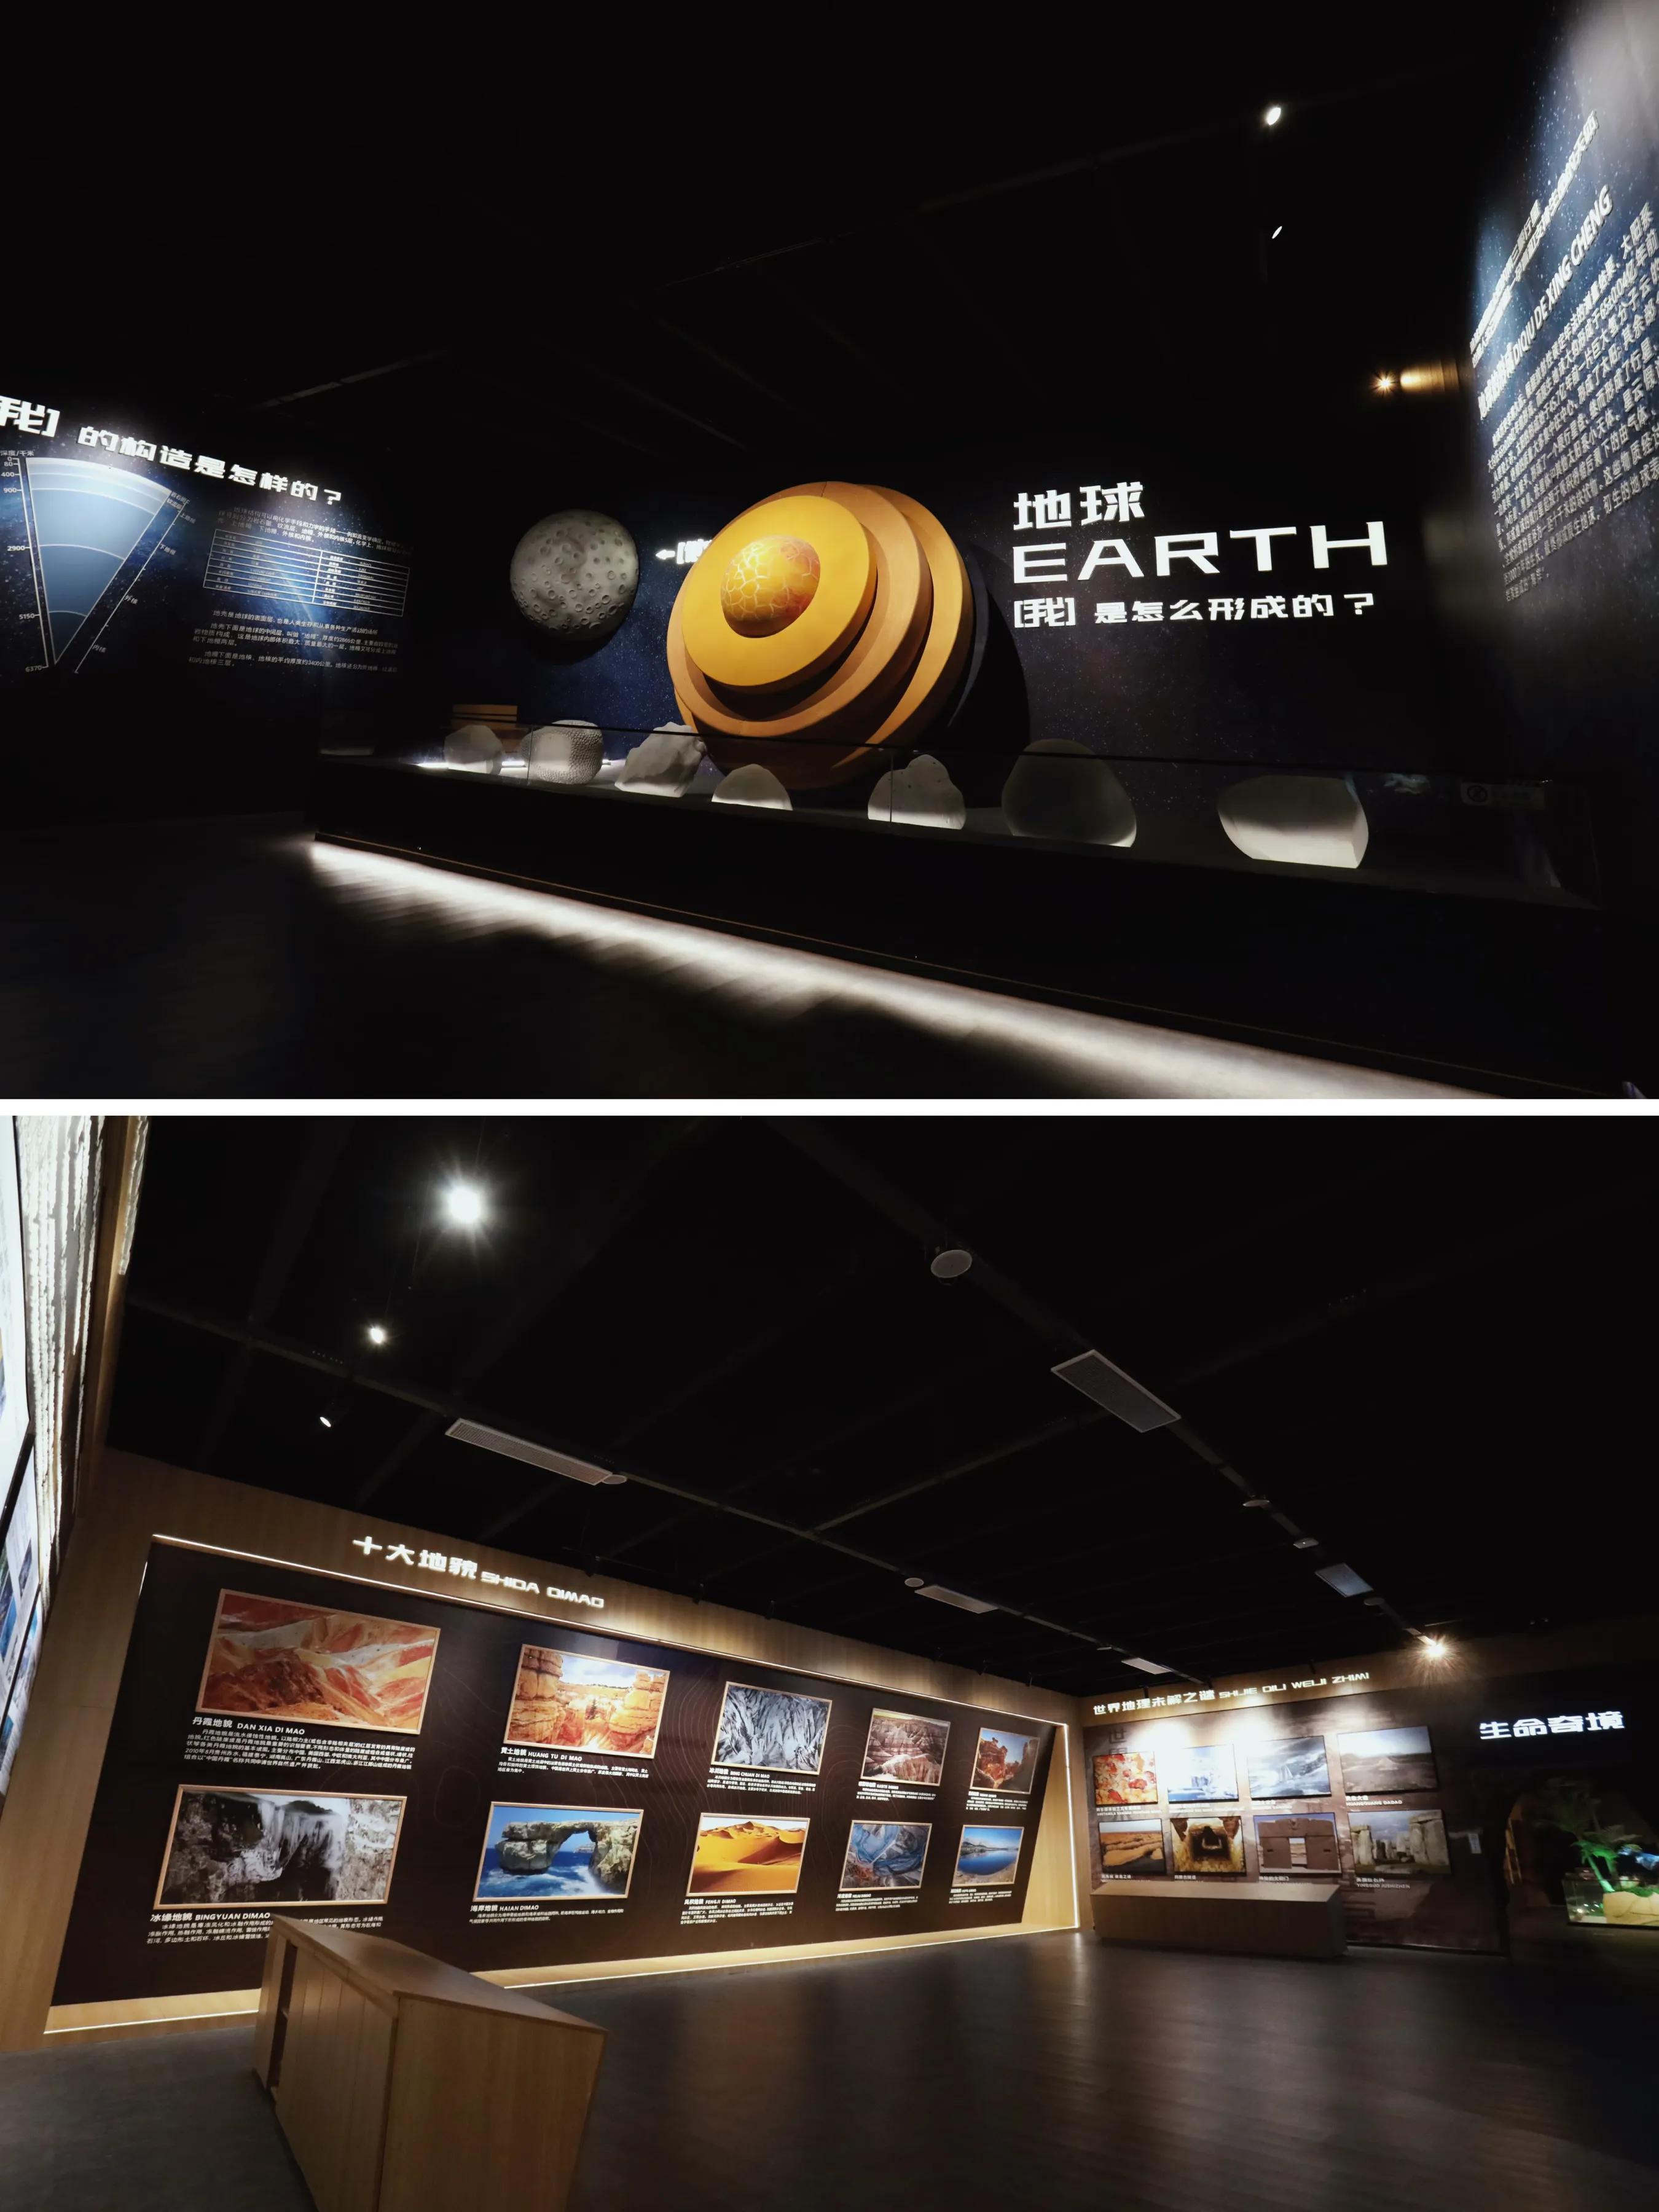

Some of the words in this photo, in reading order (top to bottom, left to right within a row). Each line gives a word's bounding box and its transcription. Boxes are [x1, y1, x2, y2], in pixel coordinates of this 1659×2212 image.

[1513, 318, 1536, 366] DIQIU
[1534, 296, 1551, 330] DE
[1546, 254, 1574, 311] XING
[1570, 184, 1614, 267] CHENG
[1013, 481, 1145, 531] 地球
[1013, 521, 1388, 583] EARTH
[1094, 593, 1374, 625] 是怎么形成的？
[352, 1535, 478, 1580] 十大地貌
[480, 1571, 540, 1594] SHIDA
[1092, 1689, 1215, 1716] 世界地理未解之谜
[1218, 1687, 1258, 1699] SHIJIE
[1332, 1672, 1370, 1684] ZHIMI
[192, 1716, 233, 1728] 丹霞地貌
[285, 1727, 305, 1735] MAO
[1480, 1711, 1625, 1740] 生命奇境
[500, 1746, 527, 1756] 黄土地貌
[150, 1912, 193, 1922] 冰缘地貌
